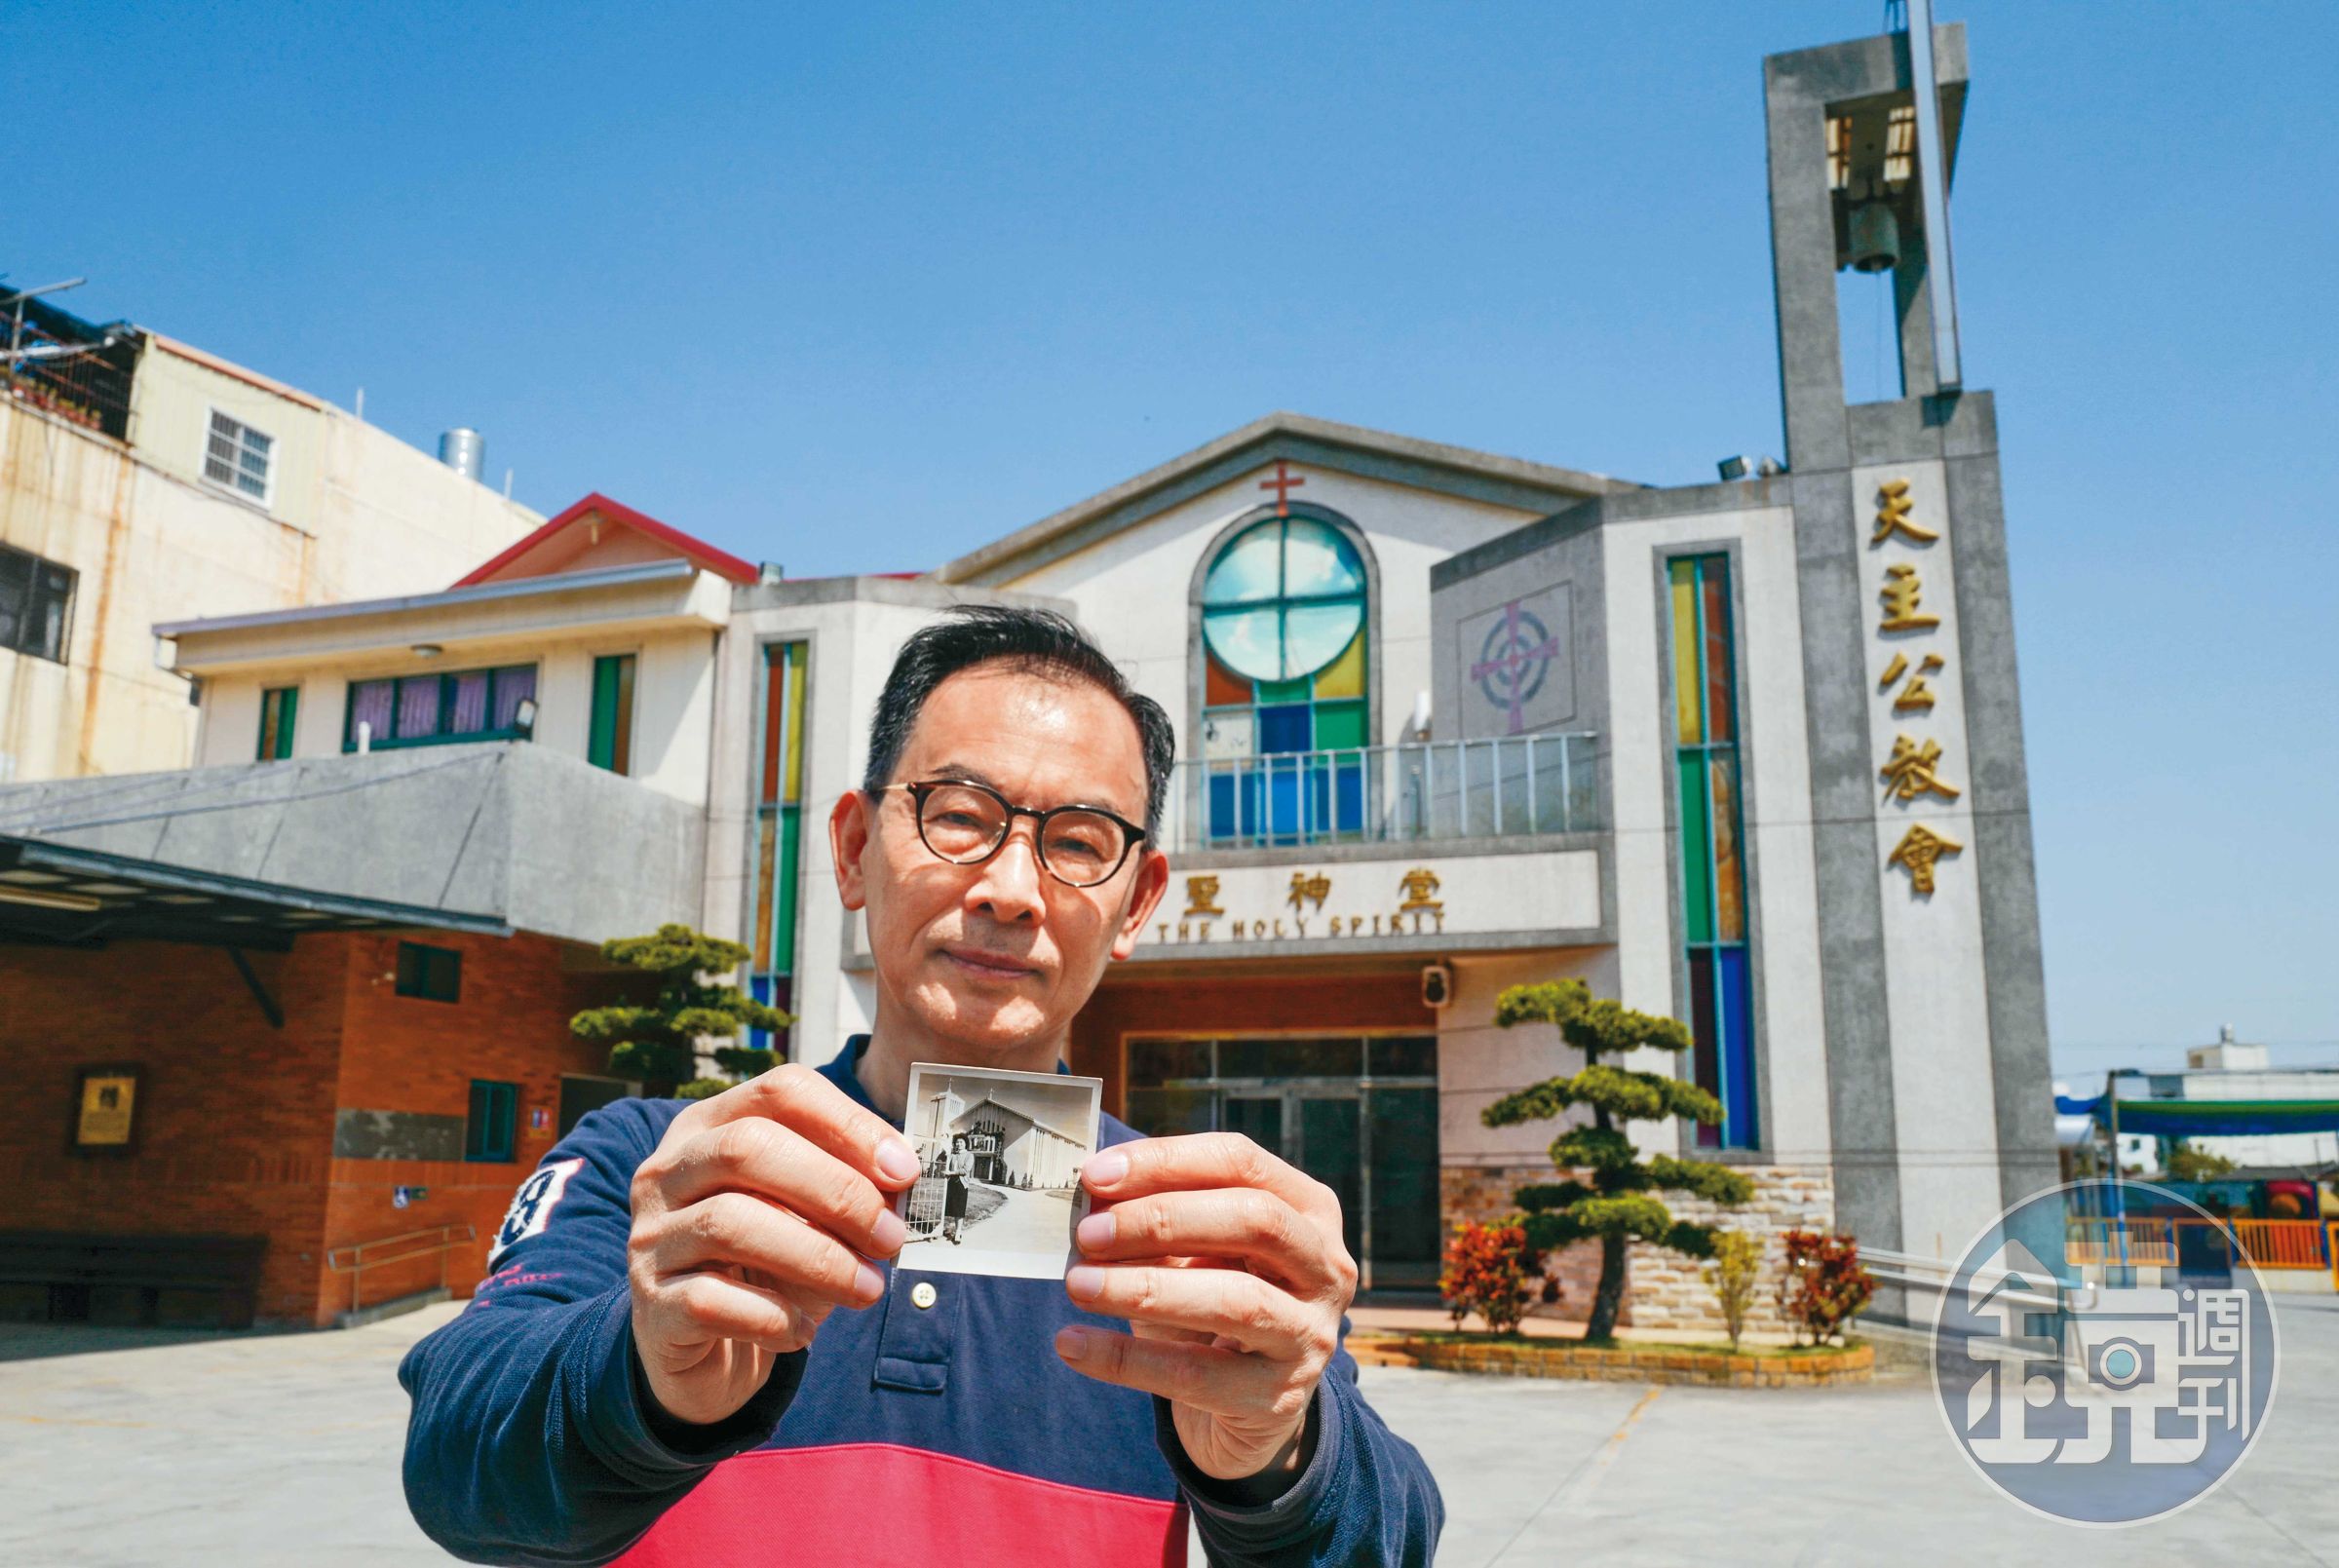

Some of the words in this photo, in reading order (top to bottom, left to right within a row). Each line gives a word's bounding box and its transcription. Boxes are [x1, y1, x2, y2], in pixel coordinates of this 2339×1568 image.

[1870, 477, 1964, 895] 天主公教會
[1183, 866, 1444, 917] 聖神堂
[1157, 920, 1210, 944] THE
[1232, 916, 1309, 941] HOLY
[1329, 910, 1445, 937] SPIRIT
